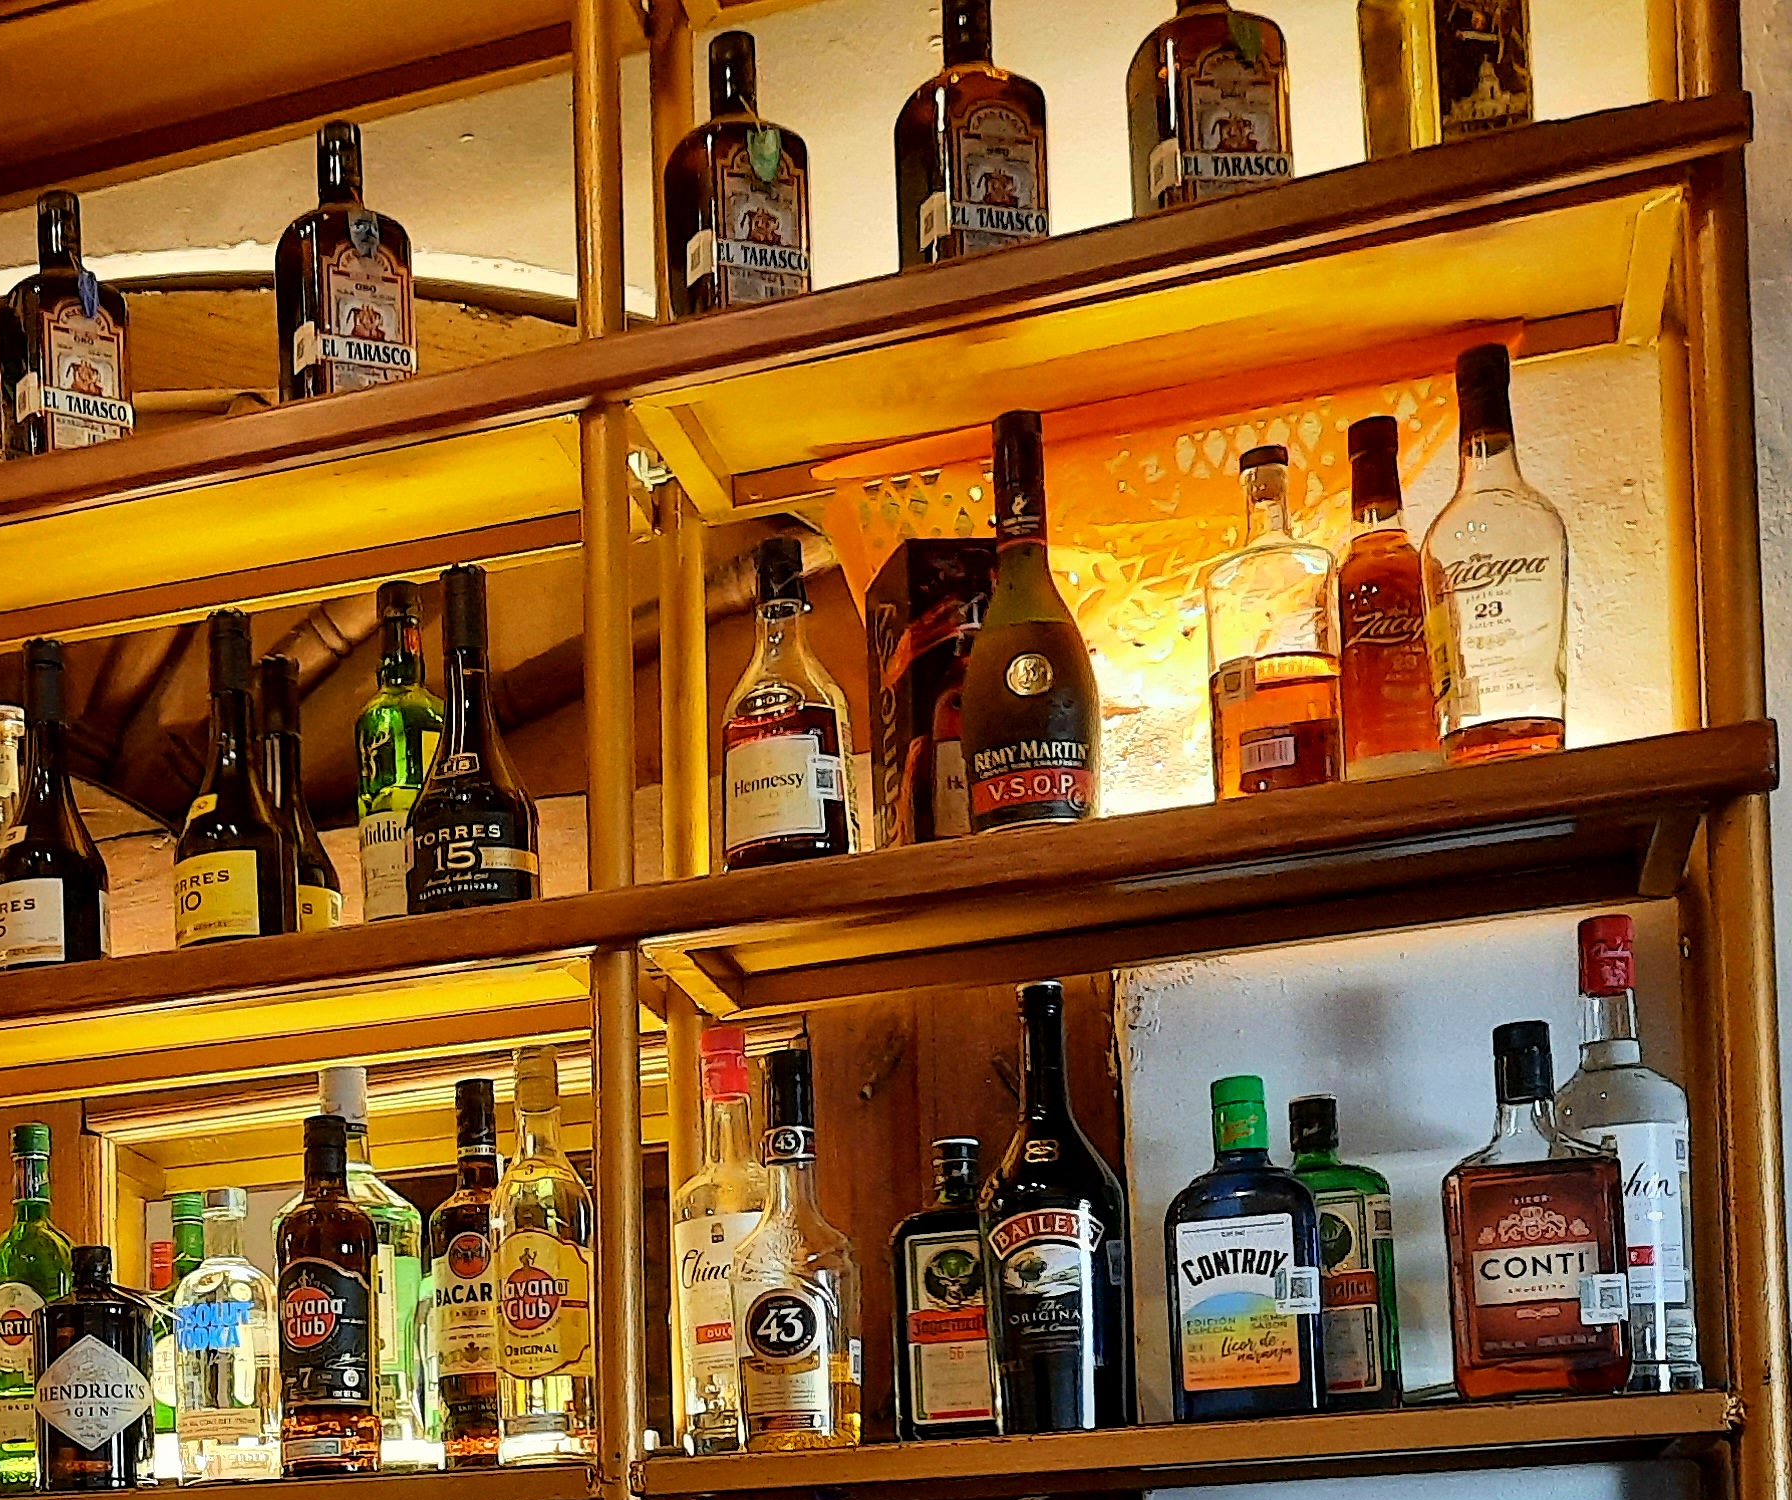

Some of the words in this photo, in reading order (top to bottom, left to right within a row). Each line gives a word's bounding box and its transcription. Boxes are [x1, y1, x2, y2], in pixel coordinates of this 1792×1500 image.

[1184, 156, 1203, 175] EL
[1212, 155, 1288, 175] TARASCO
[954, 204, 970, 223] EL
[976, 207, 1047, 232] TARASCO
[718, 244, 734, 262] EL
[740, 246, 808, 271] TARASCO
[322, 340, 340, 358] EL
[346, 341, 411, 366] TARASCO
[44, 390, 60, 409] EL
[65, 393, 127, 421] TARASCO
[1474, 601, 1503, 619] 23
[974, 746, 1017, 773] RÉMY
[1020, 740, 1089, 760] MARTIN
[734, 771, 805, 798] Hennessy
[415, 823, 502, 849] TORRES
[433, 840, 478, 873] 15
[179, 891, 202, 914] 10
[774, 1131, 797, 1151] 43
[1181, 1249, 1289, 1287] CONTROY
[1479, 1251, 1585, 1281] CONTI
[435, 1282, 493, 1307] BACAR
[507, 1299, 552, 1321] Club
[1009, 1310, 1082, 1326] ORIGINA
[286, 1317, 327, 1339] Club
[756, 1306, 805, 1344] 43
[1221, 1337, 1256, 1358] Licor
[1259, 1331, 1278, 1348] de
[1237, 1342, 1294, 1364] naranja
[299, 1367, 313, 1389] 7
[39, 1382, 146, 1402] HENDRICK'S
[74, 1405, 111, 1418] GIN
